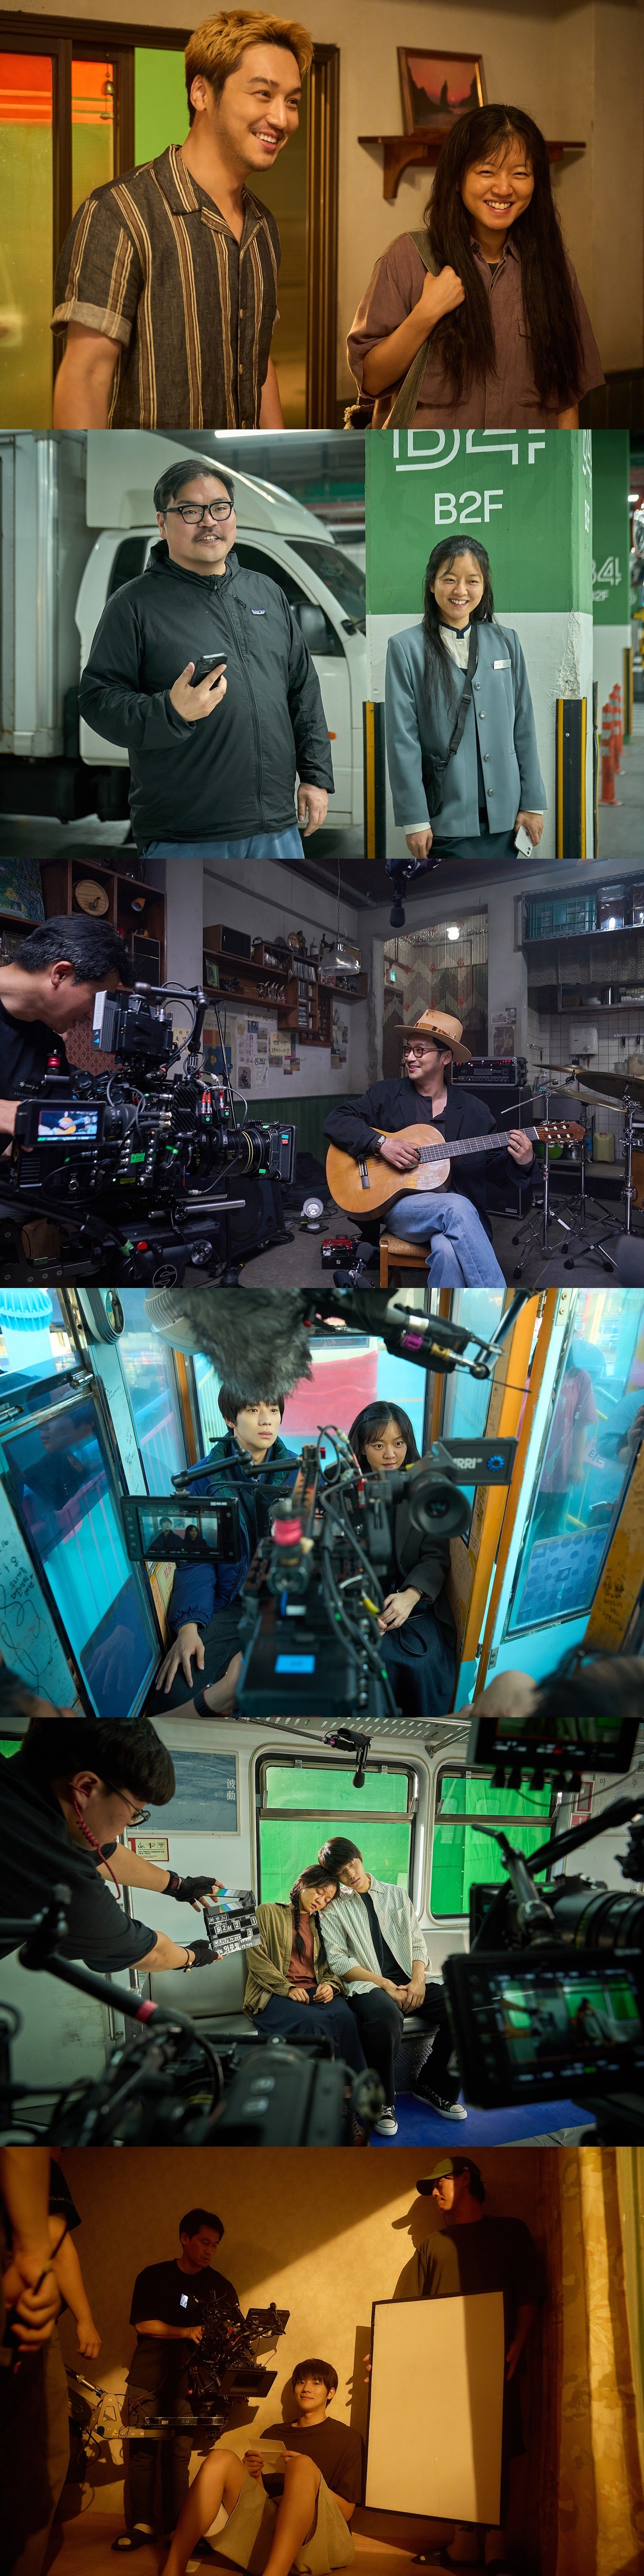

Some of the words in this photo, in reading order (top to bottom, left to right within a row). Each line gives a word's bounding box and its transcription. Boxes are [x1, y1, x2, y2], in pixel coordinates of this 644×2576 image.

[435, 489, 503, 524] B2F
[226, 1778, 236, 1801] 波動
[223, 1943, 239, 1951] 이종필
